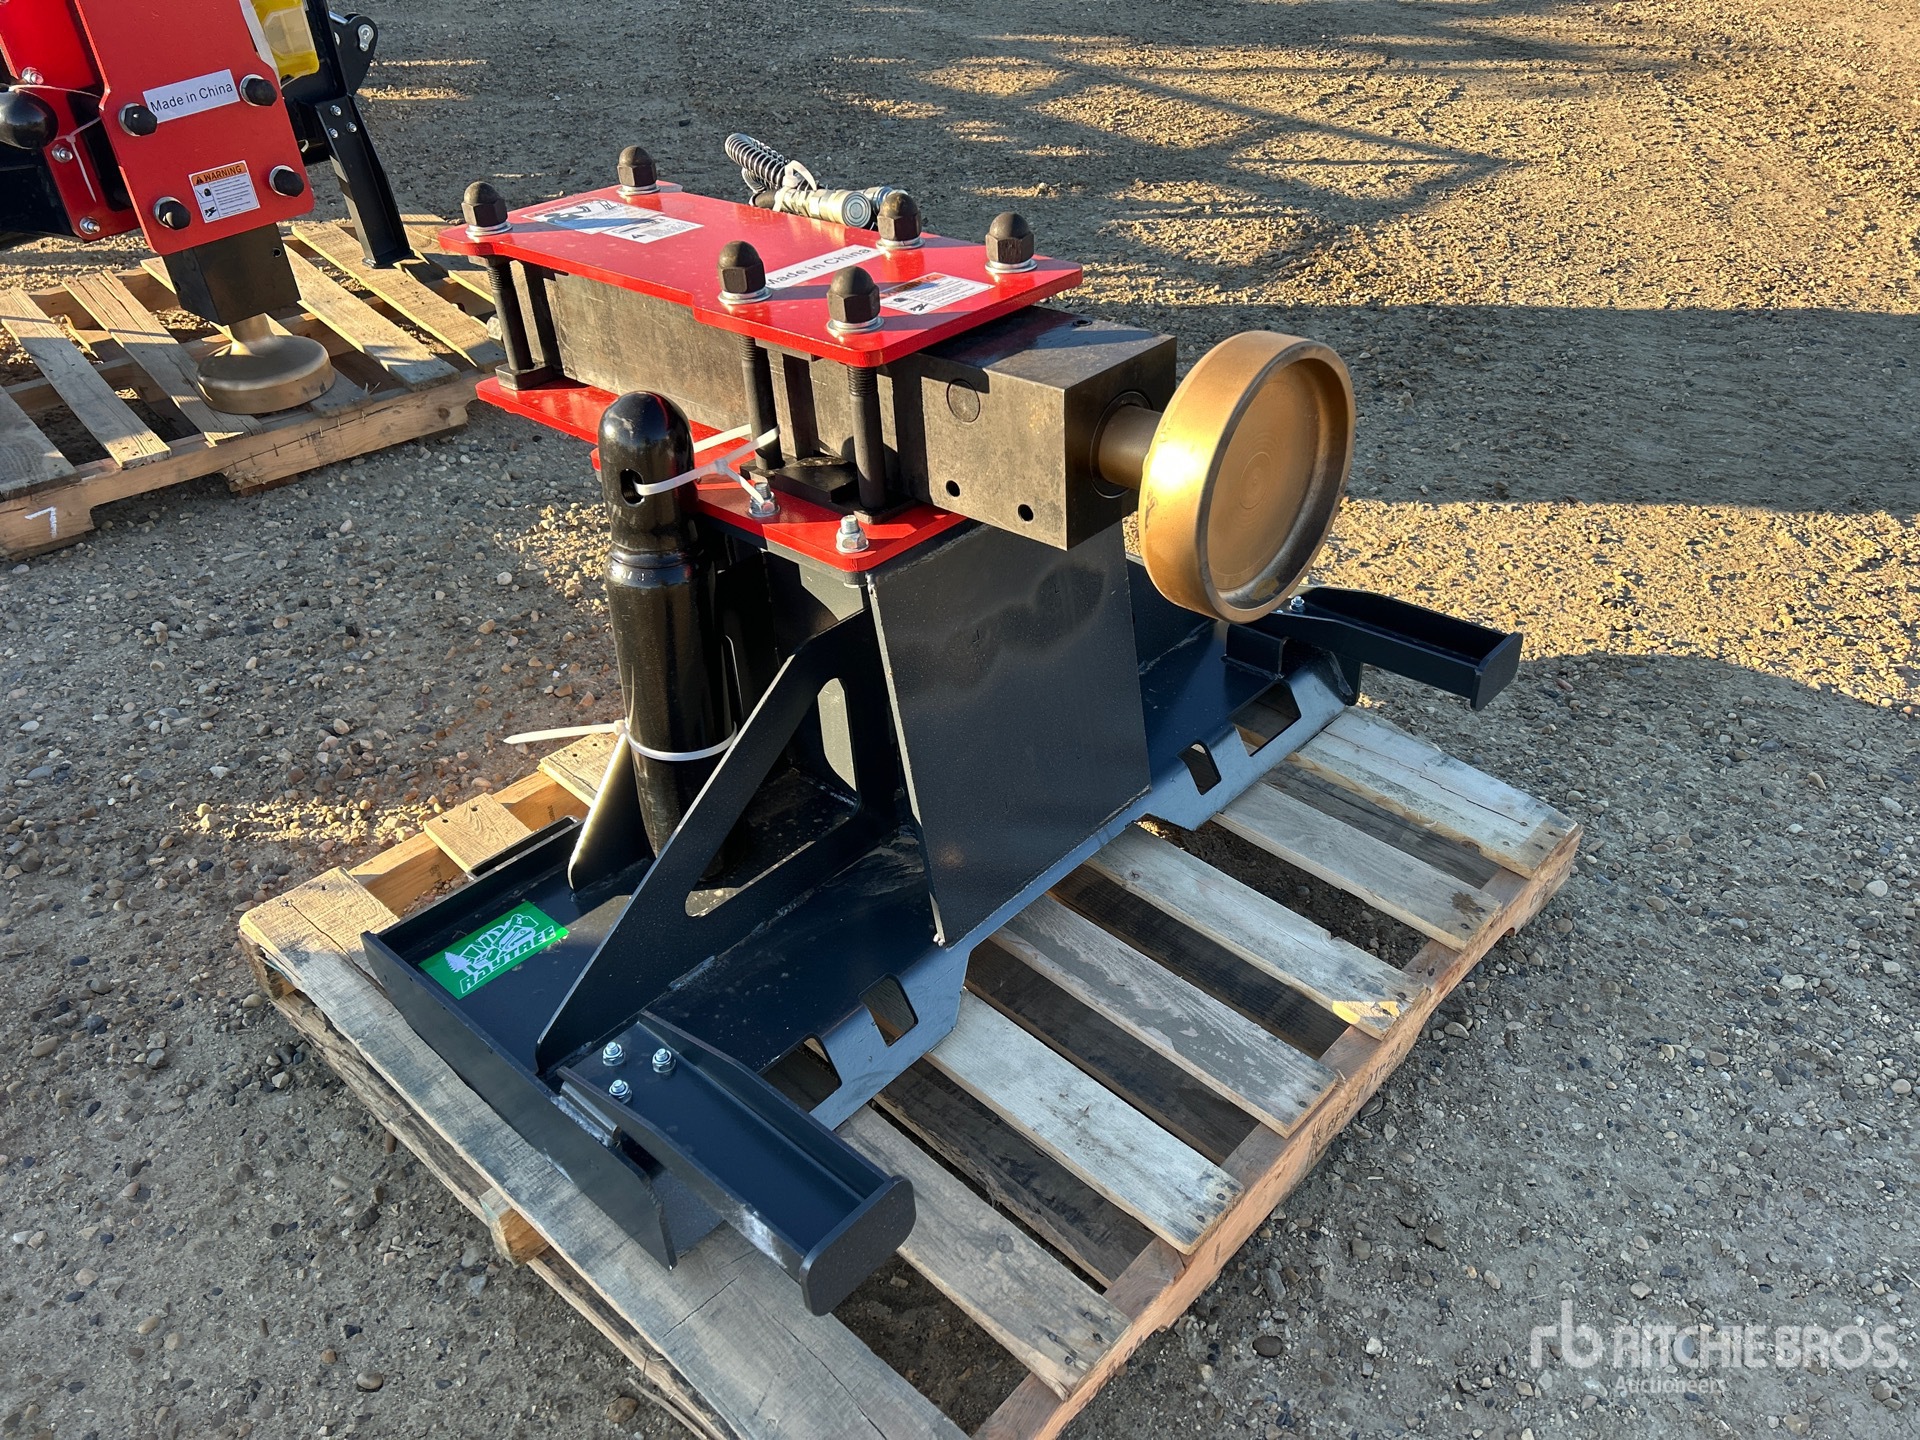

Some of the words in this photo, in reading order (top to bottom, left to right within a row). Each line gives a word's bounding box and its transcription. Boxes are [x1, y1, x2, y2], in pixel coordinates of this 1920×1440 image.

[150, 96, 184, 113] Made
[184, 92, 198, 103] in
[198, 83, 234, 99] China
[203, 165, 243, 182] WARNING
[805, 264, 826, 272] in
[823, 248, 871, 265] China
[460, 925, 556, 994] RAYTREE
